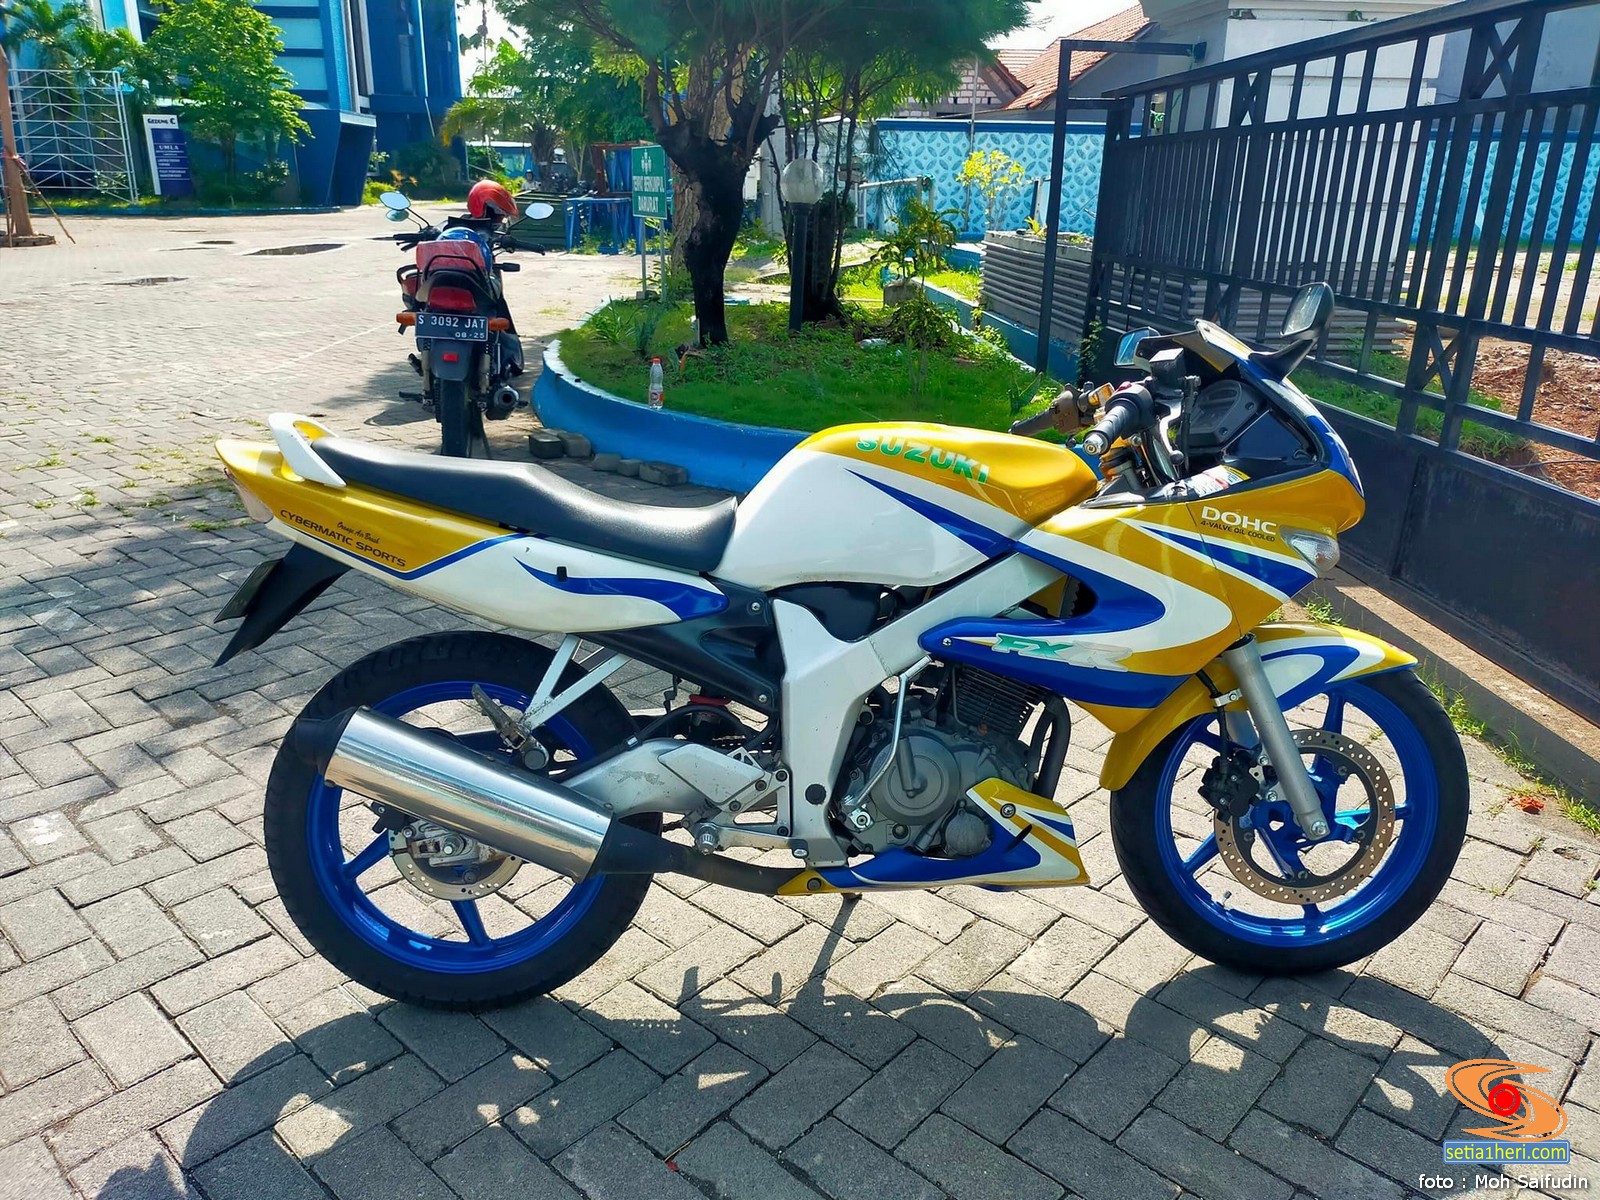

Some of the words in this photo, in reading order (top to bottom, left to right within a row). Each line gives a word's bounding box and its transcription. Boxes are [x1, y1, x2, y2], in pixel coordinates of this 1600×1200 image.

[418, 314, 425, 325] S
[431, 316, 459, 328] 3092
[465, 319, 485, 329] JAT
[855, 434, 991, 484] SUZUKI
[1200, 520, 1232, 533] 4-VALVE
[1234, 527, 1246, 535] OIL
[1248, 530, 1276, 542] COOLED
[1201, 505, 1277, 535] DOHC
[280, 509, 353, 546] CYBERMATIC
[355, 541, 407, 567] SPORTS
